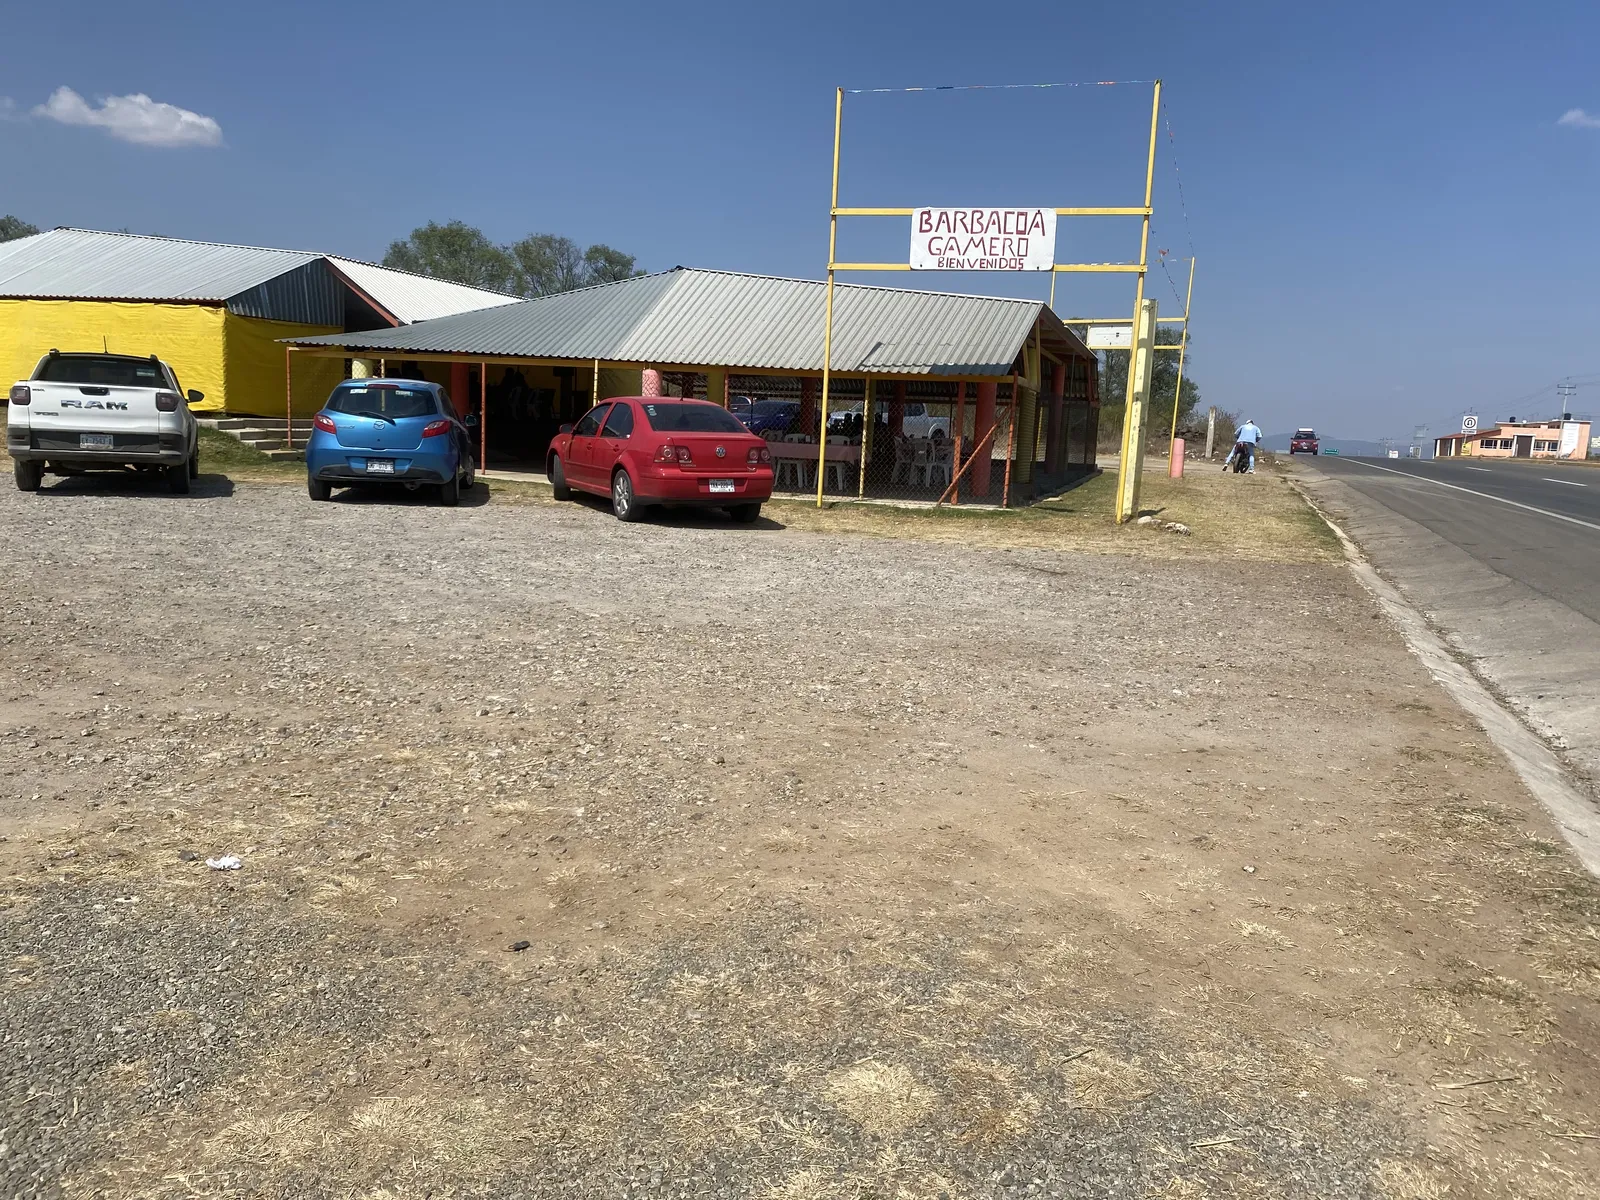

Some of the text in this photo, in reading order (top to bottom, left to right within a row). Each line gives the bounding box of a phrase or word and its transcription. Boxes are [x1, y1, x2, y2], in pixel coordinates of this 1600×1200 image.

[919, 210, 1045, 236] BARBACOA
[928, 236, 1029, 257] GAMERO
[937, 257, 1024, 270] BIENVENIDOS
[61, 400, 128, 410] RAM
